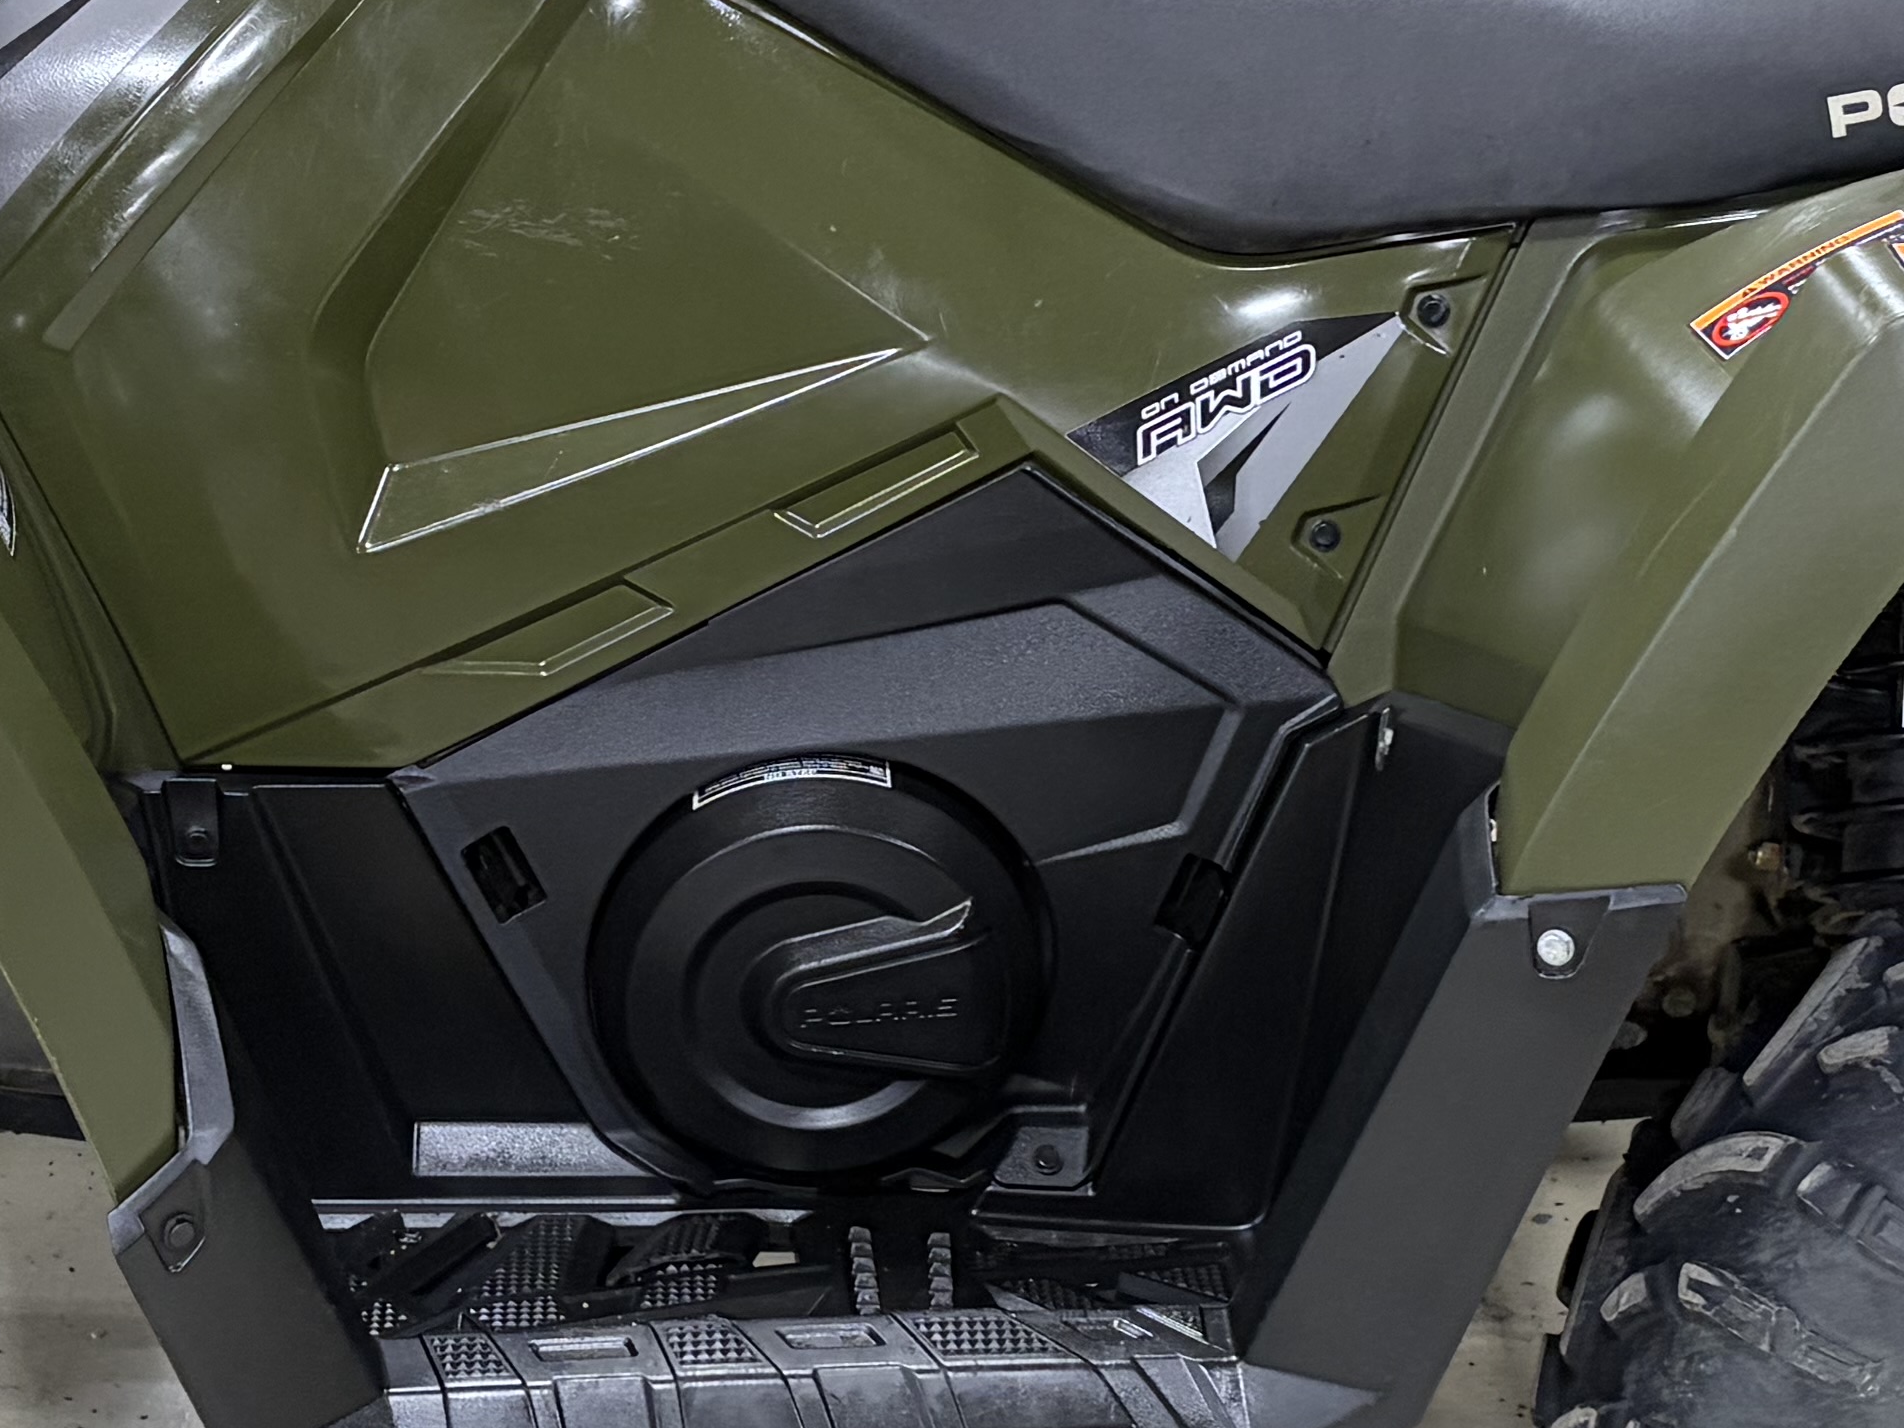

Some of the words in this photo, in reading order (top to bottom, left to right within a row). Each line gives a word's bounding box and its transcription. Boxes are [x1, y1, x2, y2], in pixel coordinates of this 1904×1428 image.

[1755, 234, 1852, 286] WARNING
[1136, 342, 1317, 466] AWD
[799, 998, 958, 1029] POLARIS
